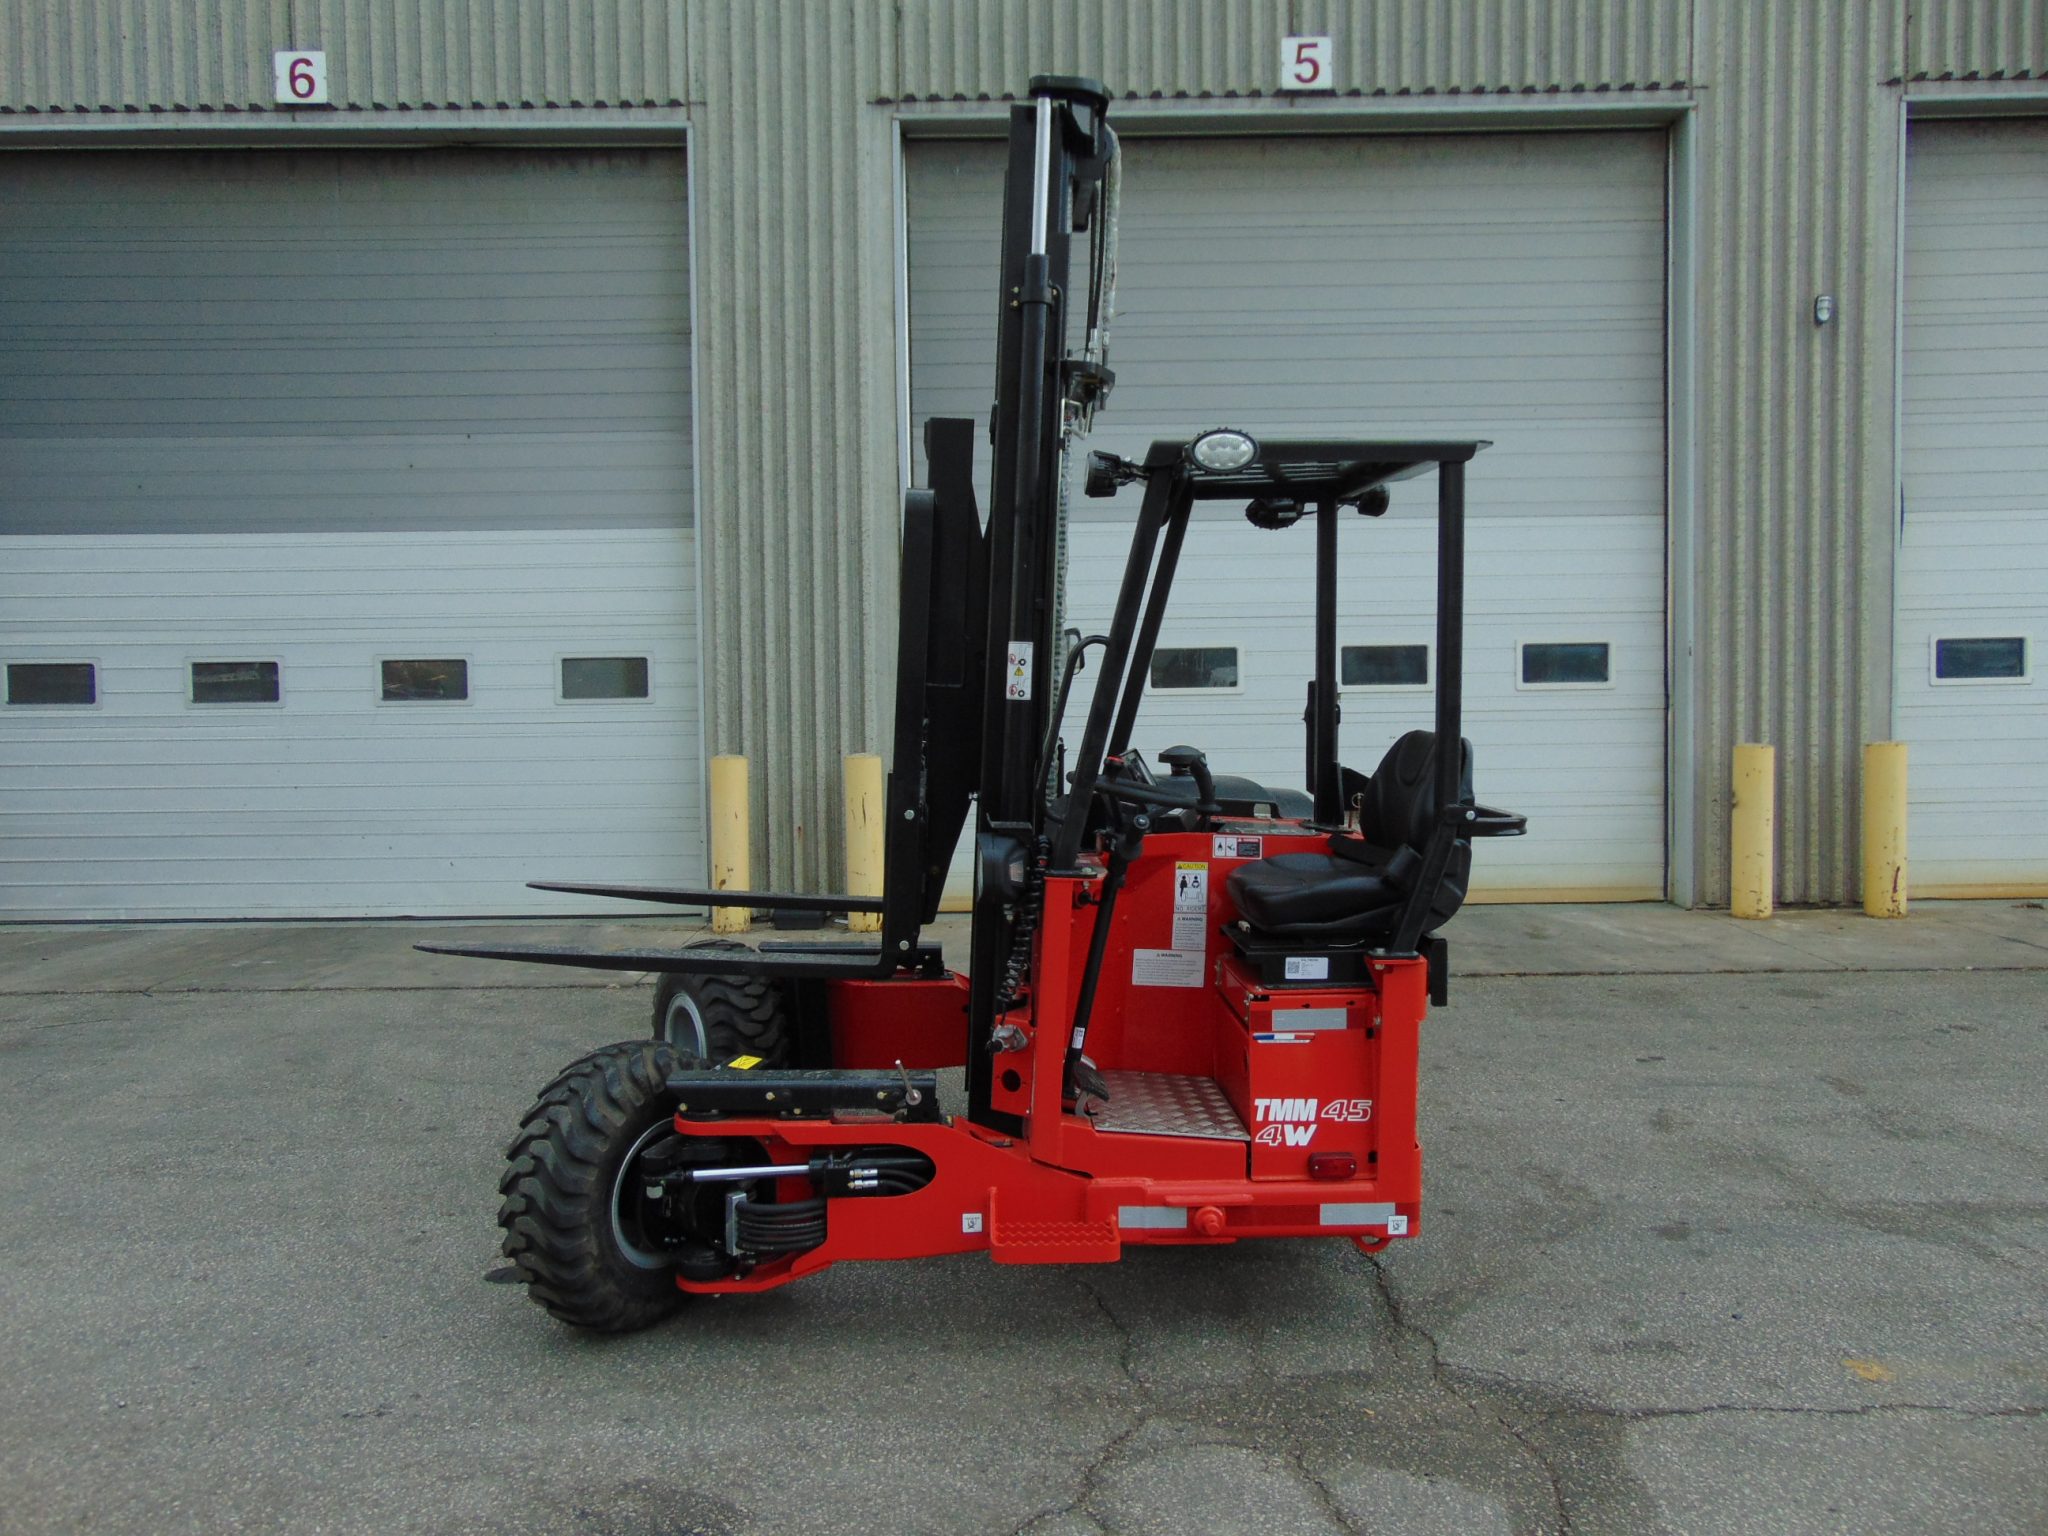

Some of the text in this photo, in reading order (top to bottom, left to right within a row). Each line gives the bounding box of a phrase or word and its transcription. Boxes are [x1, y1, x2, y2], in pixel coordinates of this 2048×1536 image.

[289, 57, 316, 99] 6
[1294, 42, 1320, 84] 5
[1254, 1098, 1373, 1122] TMM 45
[1255, 1124, 1318, 1147] 4W
